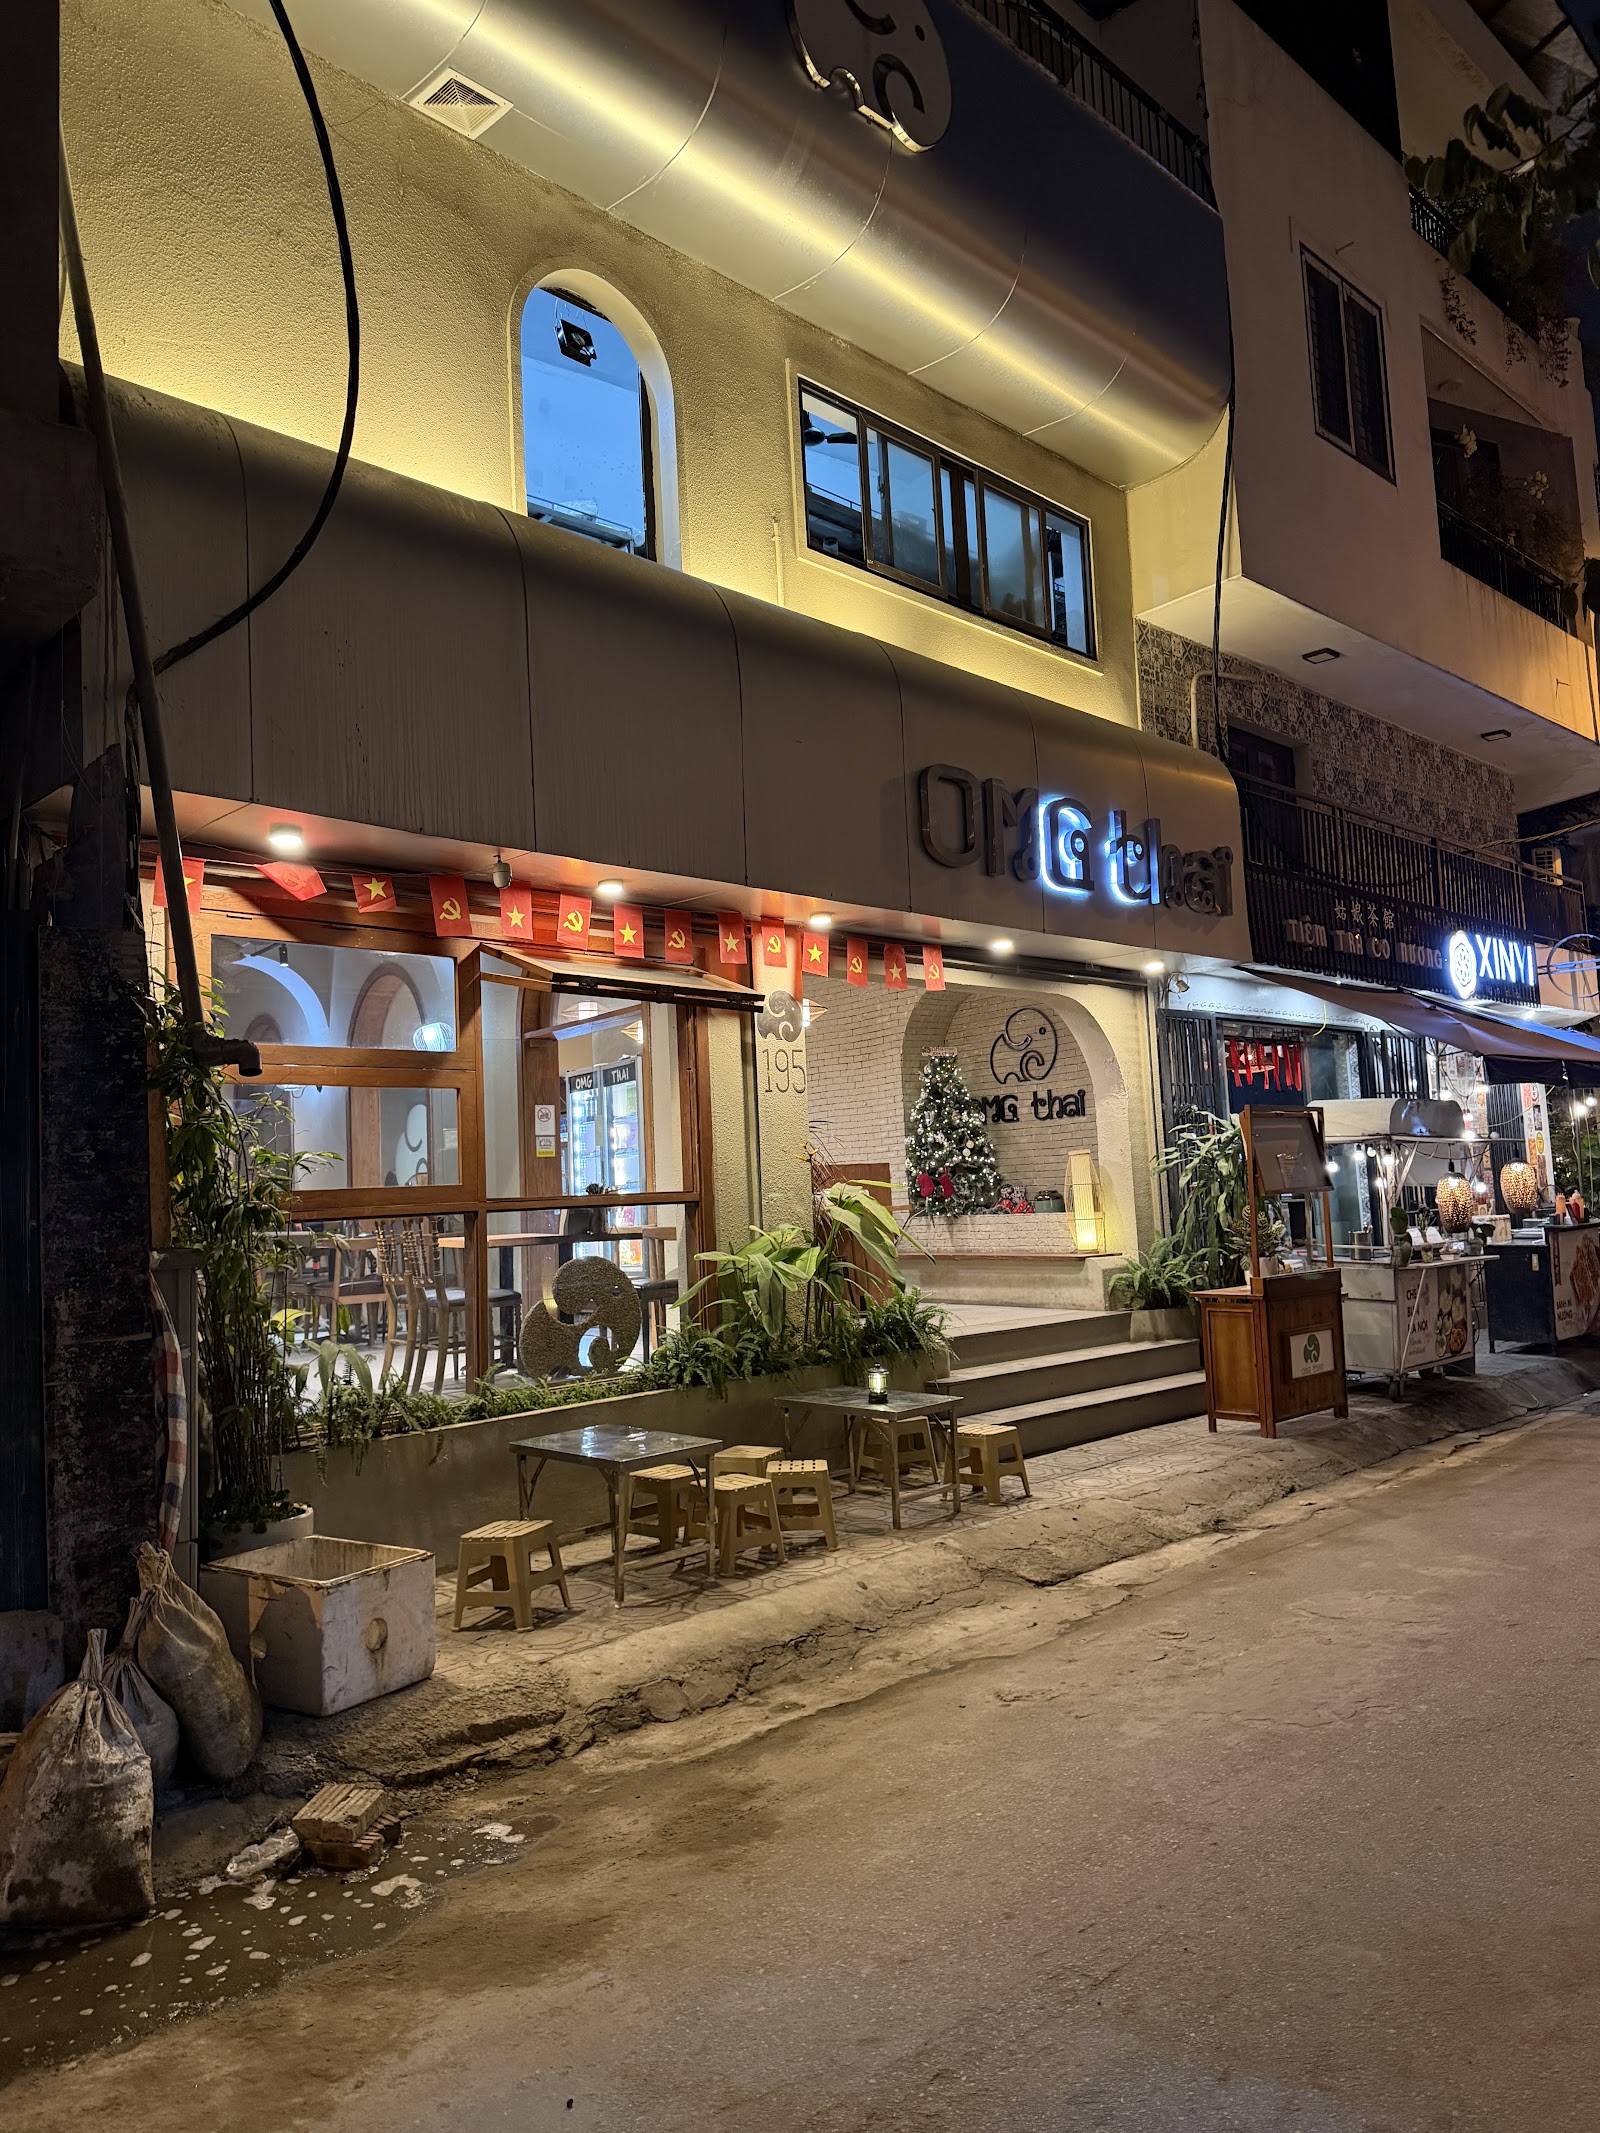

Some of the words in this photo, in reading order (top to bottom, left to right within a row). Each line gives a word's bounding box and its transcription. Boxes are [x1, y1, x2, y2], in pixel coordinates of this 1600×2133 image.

[1475, 934, 1535, 987] XINYI
[575, 1075, 593, 1090] OMG
[611, 1067, 629, 1084] THAI
[762, 1048, 807, 1094] 195
